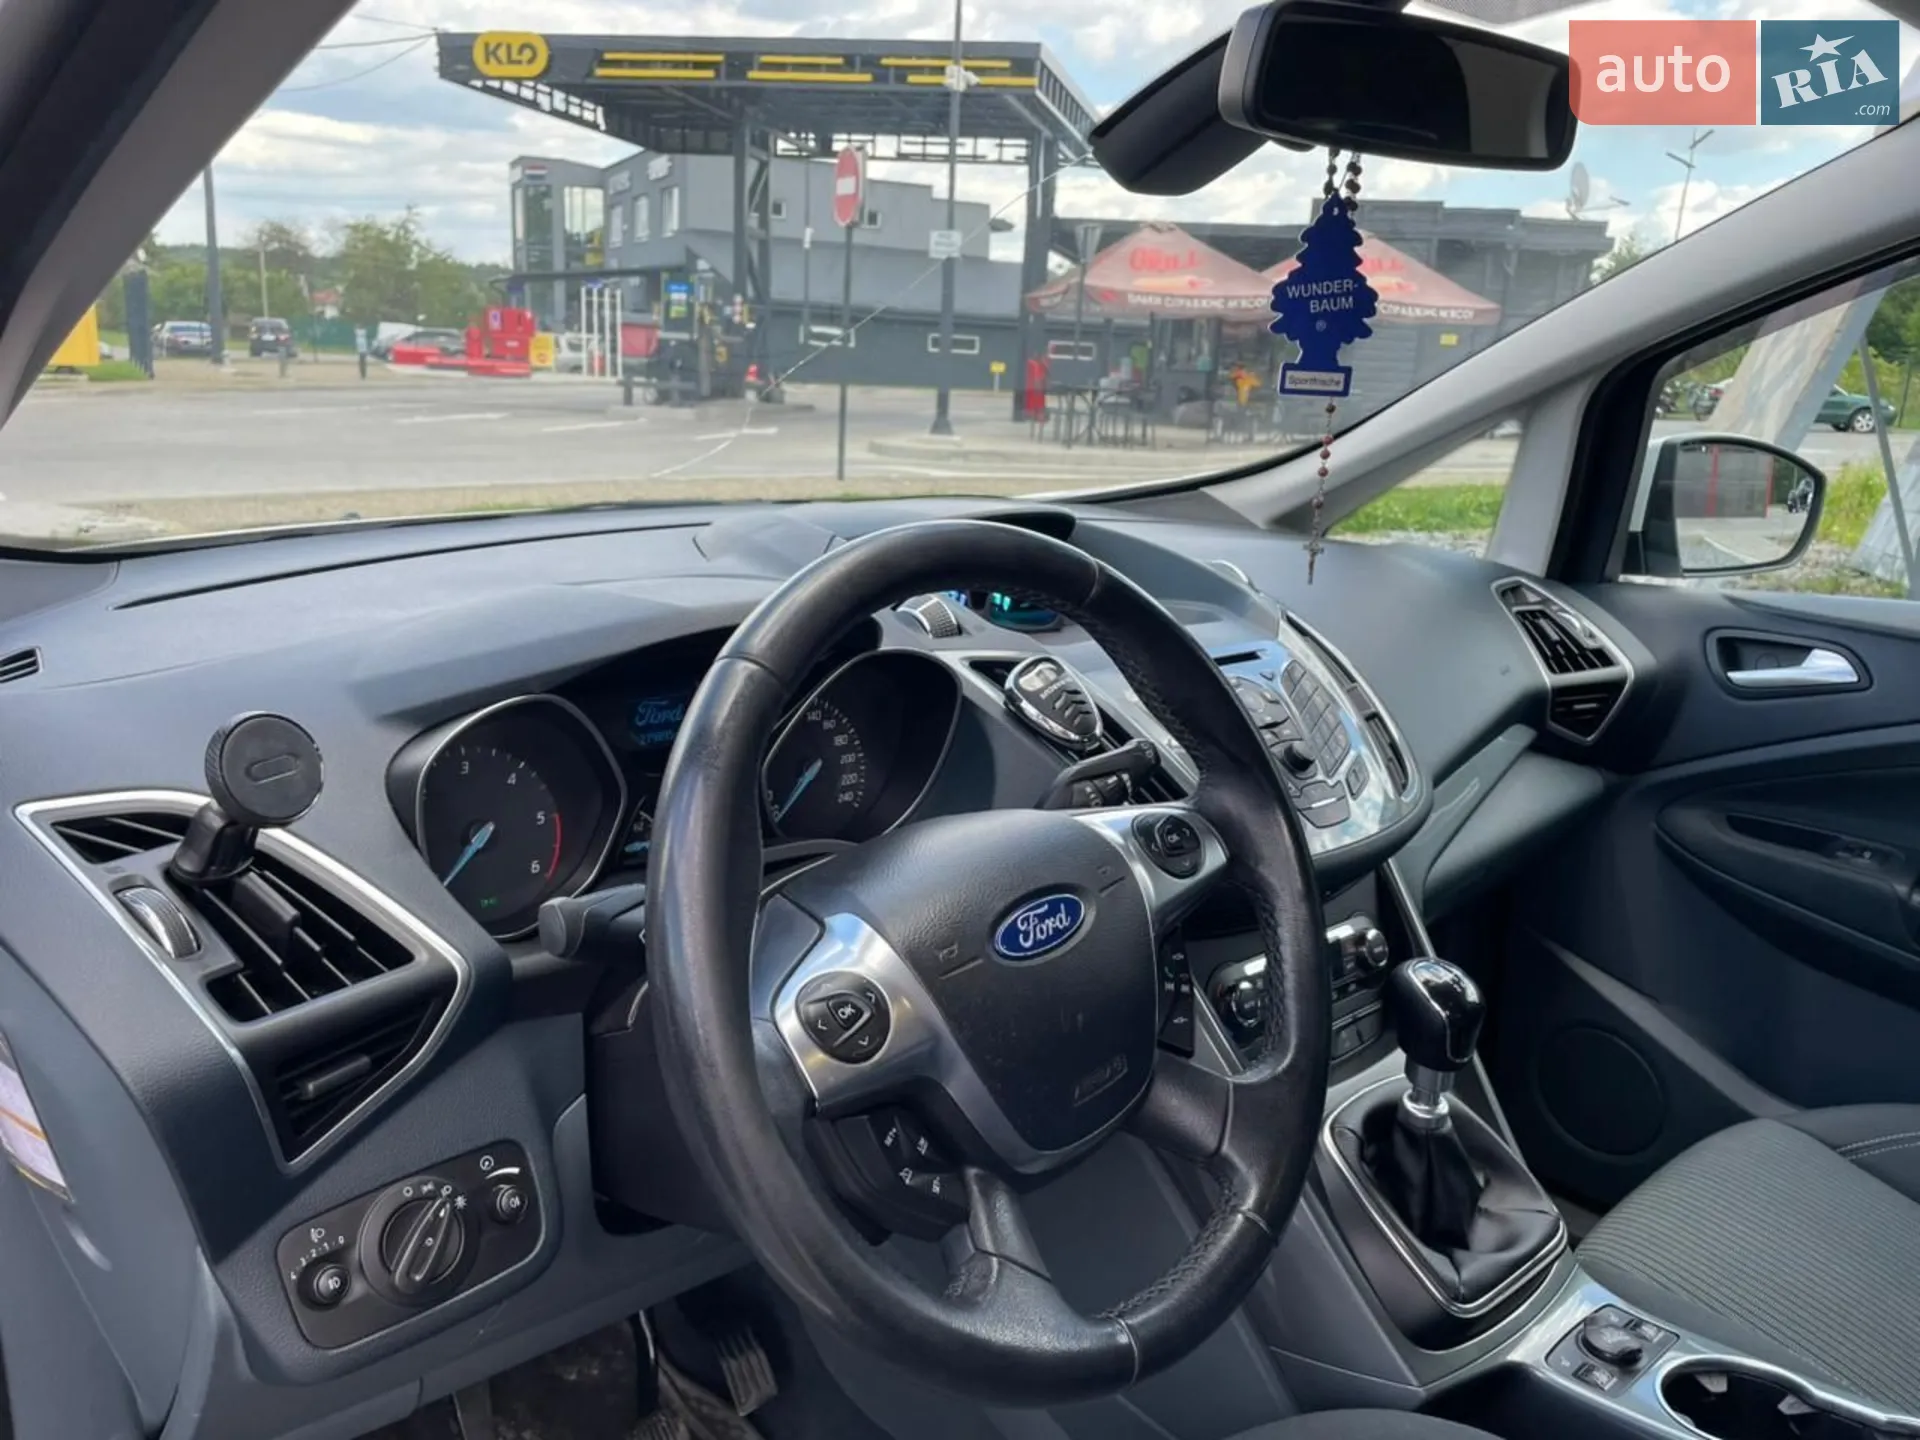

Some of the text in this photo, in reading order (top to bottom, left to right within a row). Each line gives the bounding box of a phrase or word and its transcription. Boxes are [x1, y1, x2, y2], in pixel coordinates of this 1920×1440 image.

[1286, 279, 1358, 299] WUNDER-
[1309, 296, 1354, 313] BAUM
[460, 761, 469, 775] 3
[507, 773, 517, 785] 4
[536, 811, 546, 825] 5
[530, 860, 540, 874] 6
[1017, 903, 1071, 948] Ford
[838, 1004, 856, 1019] OK
